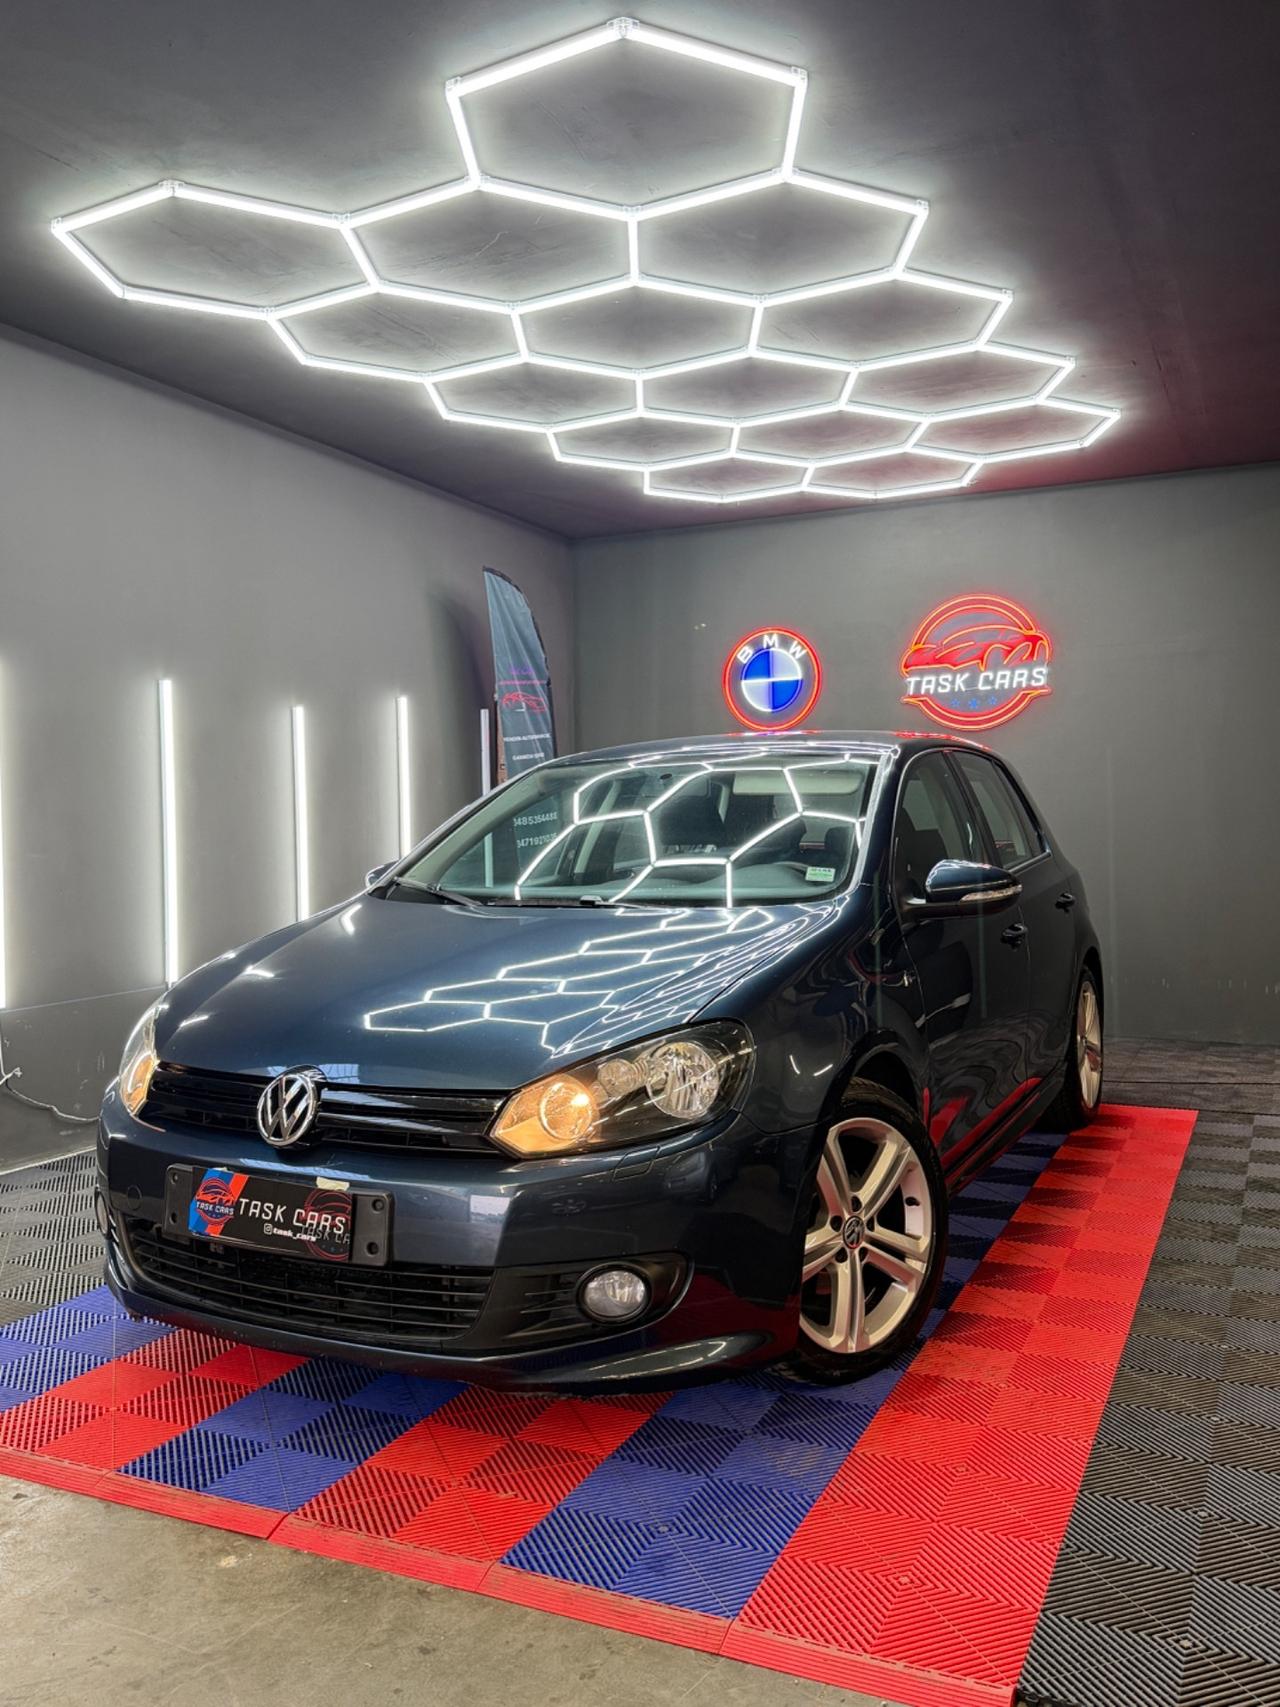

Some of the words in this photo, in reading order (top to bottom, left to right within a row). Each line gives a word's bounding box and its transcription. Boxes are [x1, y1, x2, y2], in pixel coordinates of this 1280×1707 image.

[736, 633, 807, 664] BMW
[907, 670, 966, 695] TASK
[978, 667, 1048, 691] CARS
[196, 1201, 214, 1211] TASK
[215, 1205, 234, 1216] CARS
[239, 1198, 287, 1223] TASK
[293, 1208, 346, 1234] CARS
